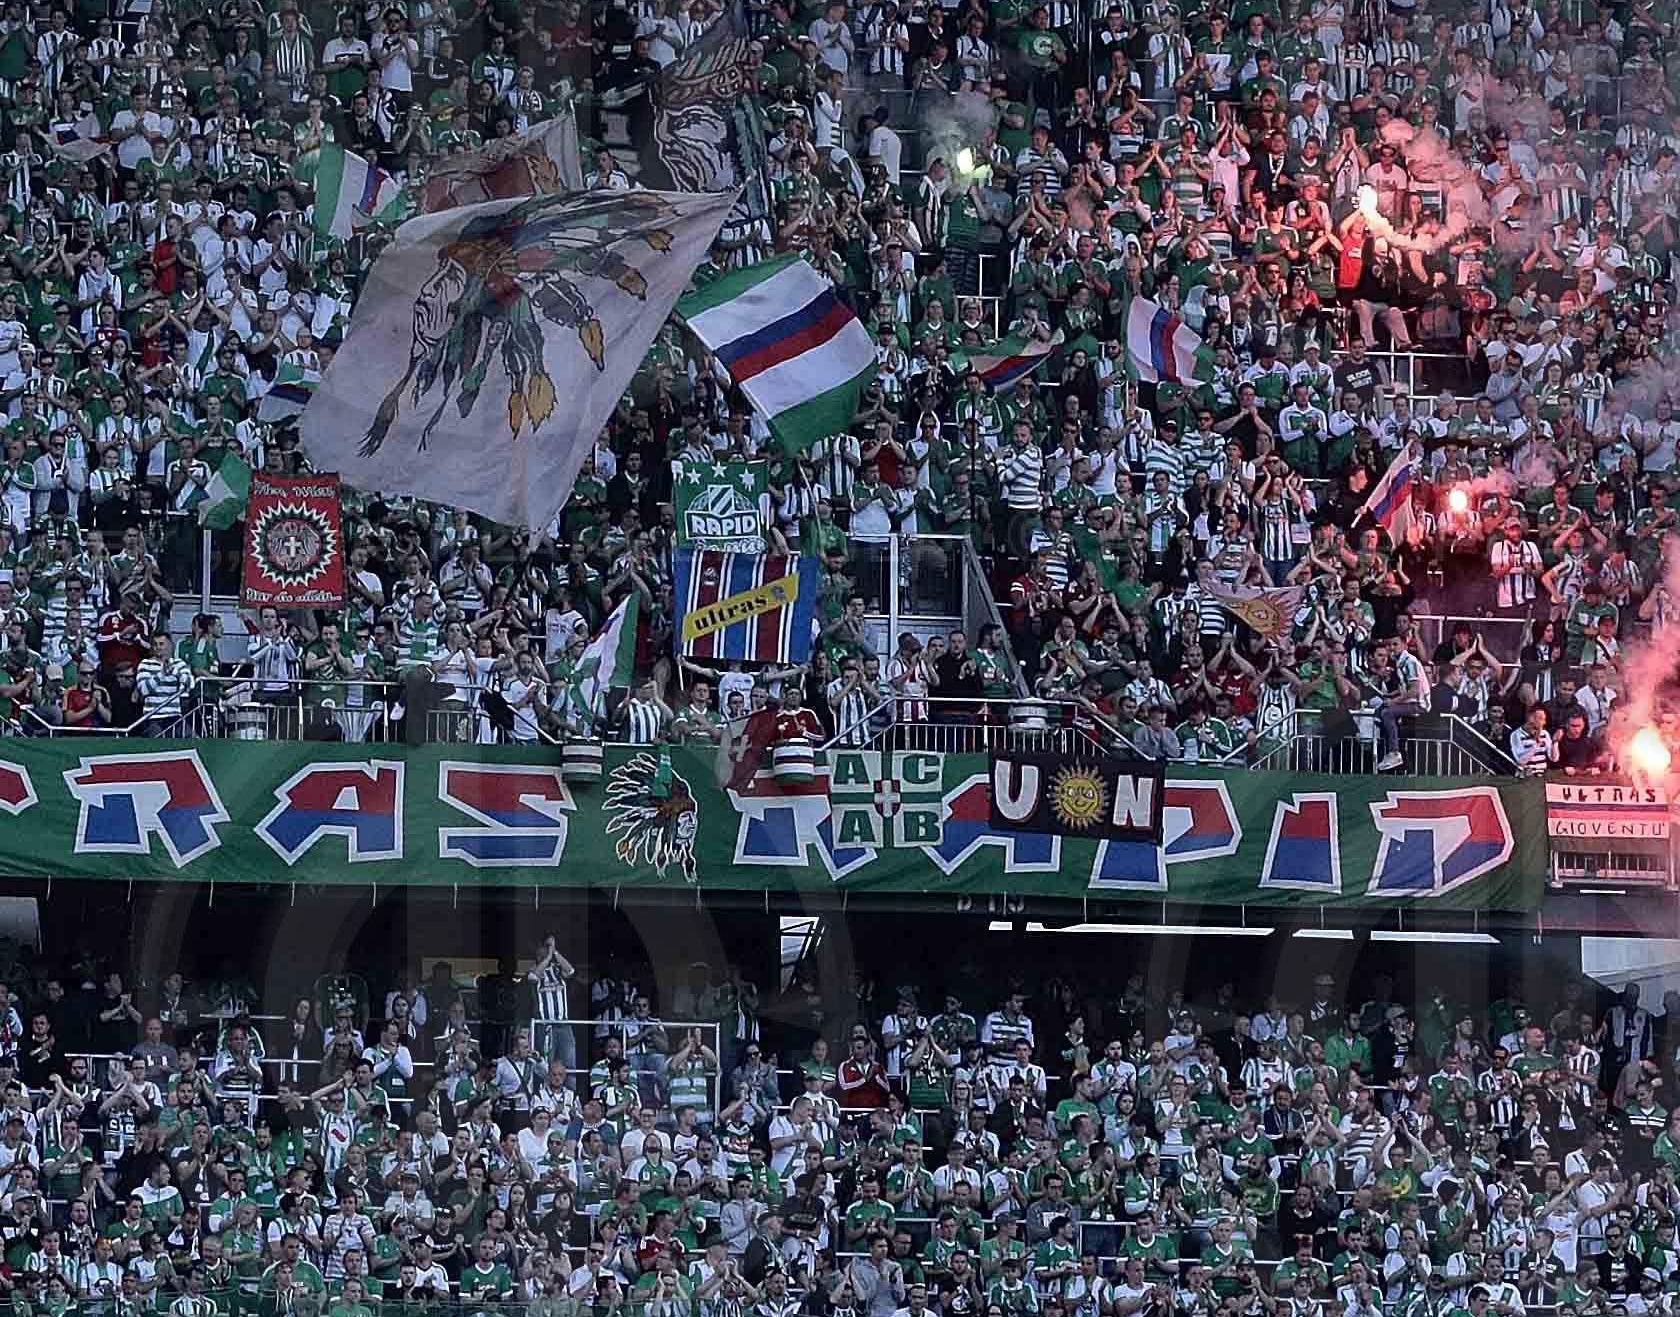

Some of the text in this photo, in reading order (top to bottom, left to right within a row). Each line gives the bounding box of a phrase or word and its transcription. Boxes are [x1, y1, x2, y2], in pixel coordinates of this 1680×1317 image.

[692, 515, 758, 537] RAPID
[693, 593, 769, 632] ultras
[835, 753, 940, 785] A C
[1561, 786, 1657, 803] ULTRAS
[726, 768, 1516, 897] RAPID
[838, 809, 940, 845] A B
